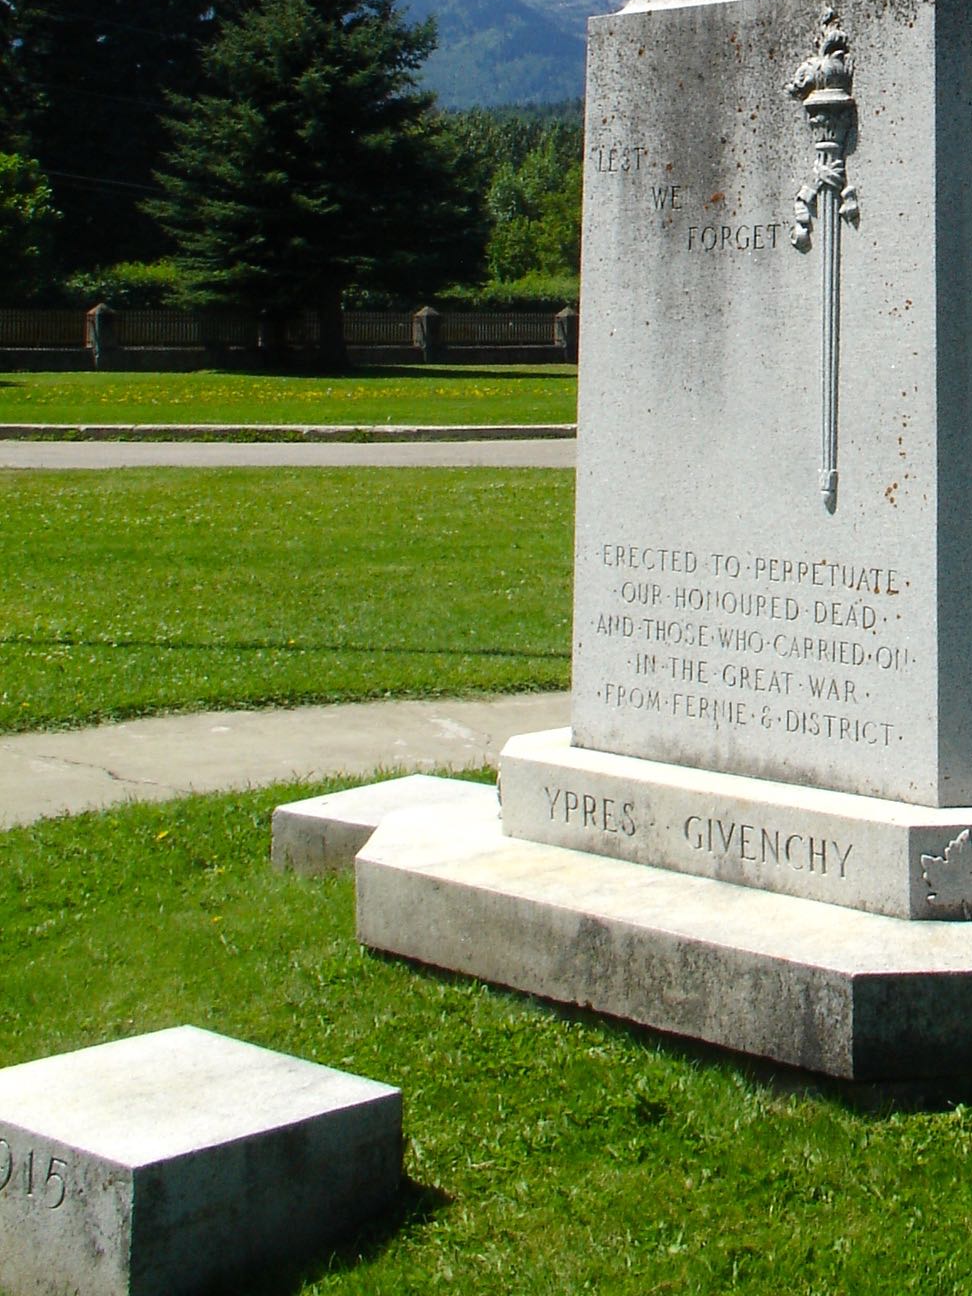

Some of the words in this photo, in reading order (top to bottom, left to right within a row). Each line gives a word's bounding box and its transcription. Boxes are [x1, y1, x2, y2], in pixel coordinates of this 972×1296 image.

[651, 185, 683, 210] WE
[603, 545, 698, 573] ERECTED
[711, 554, 741, 578] TO
[755, 558, 901, 595] PERPETUATE
[622, 582, 662, 606] OUR
[675, 588, 800, 622] HONOURED
[814, 601, 877, 630] DEAD
[596, 613, 634, 638] AND
[644, 619, 710, 648] THOSE
[719, 627, 764, 654] WHO
[773, 633, 865, 667] CARRIED
[876, 646, 909, 672] ON
[636, 653, 657, 675] IN
[669, 657, 709, 684] THE
[722, 664, 794, 695] GREAT
[808, 675, 857, 703] WAR
[606, 683, 661, 713] FROM
[673, 693, 747, 730] FERNIE
[761, 705, 772, 730] &
[786, 709, 896, 747] DISTRICT
[544, 786, 636, 837] YPRES
[684, 815, 854, 878] GIVENCHY
